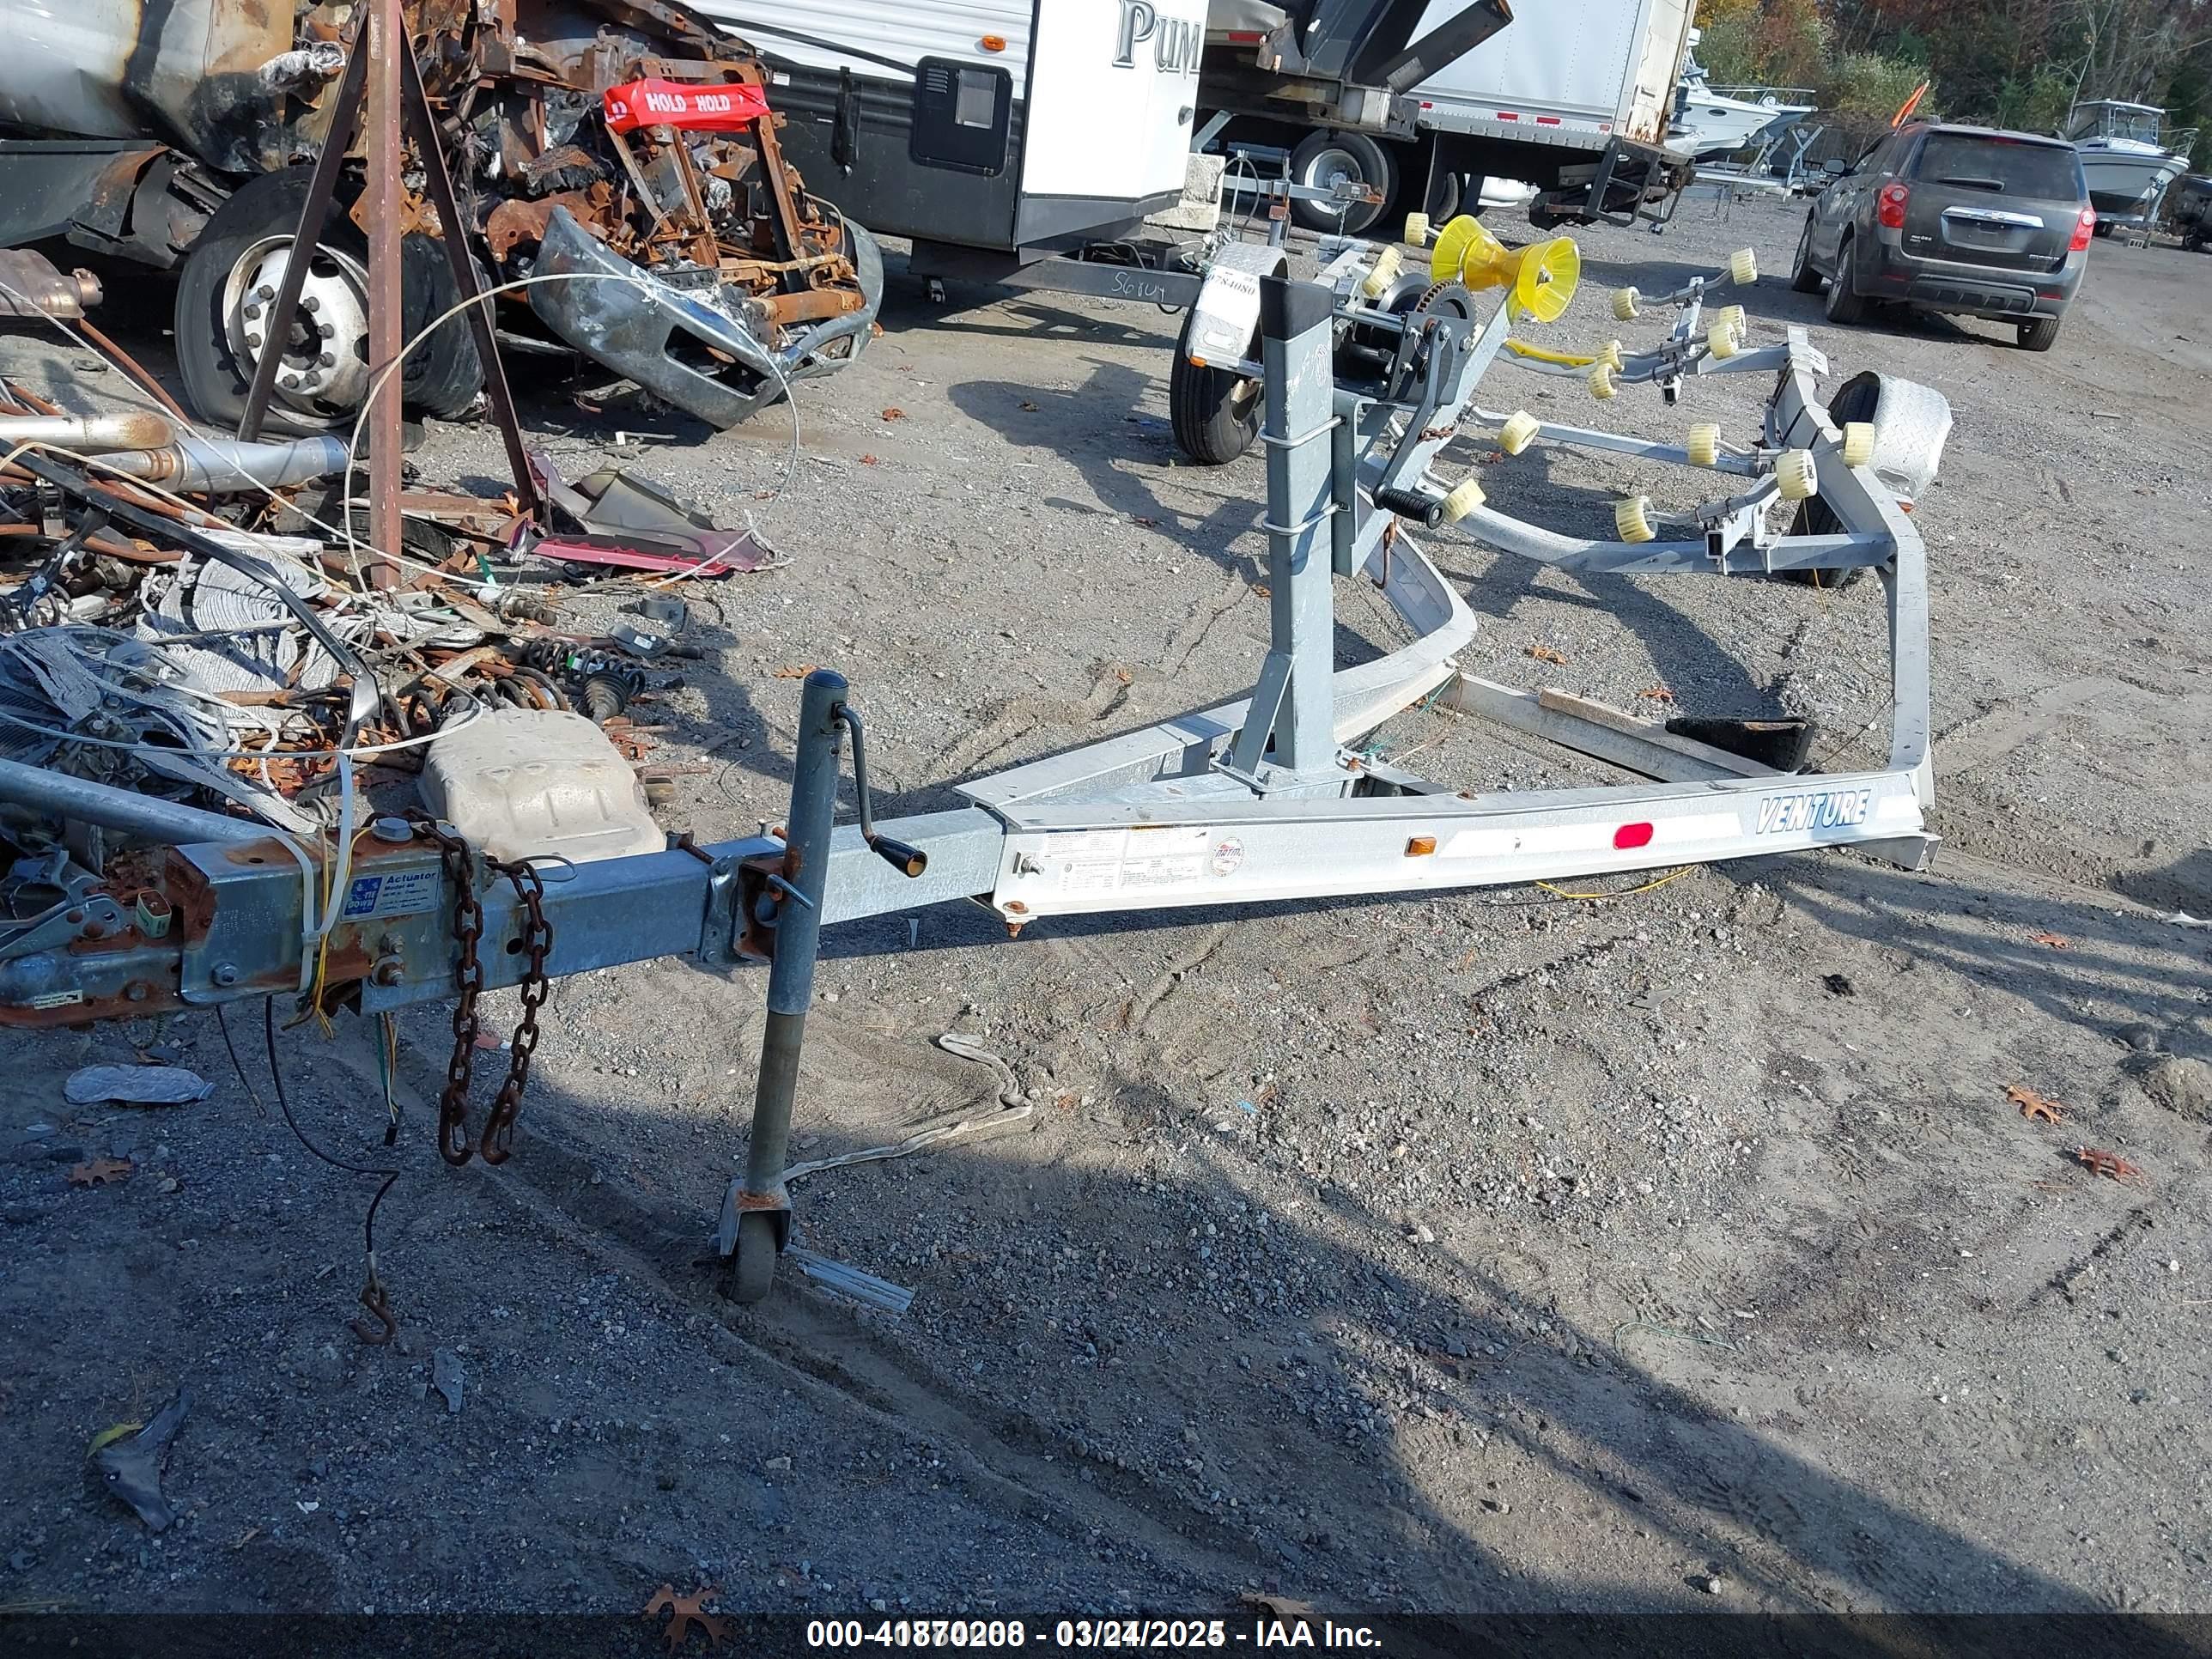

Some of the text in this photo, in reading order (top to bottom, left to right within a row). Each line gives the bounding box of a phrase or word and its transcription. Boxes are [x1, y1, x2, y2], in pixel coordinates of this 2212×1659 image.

[645, 92, 687, 112] HOLD
[695, 94, 731, 112] HOLD
[1756, 788, 1872, 835] VENTURE
[386, 872, 437, 884] Actuator
